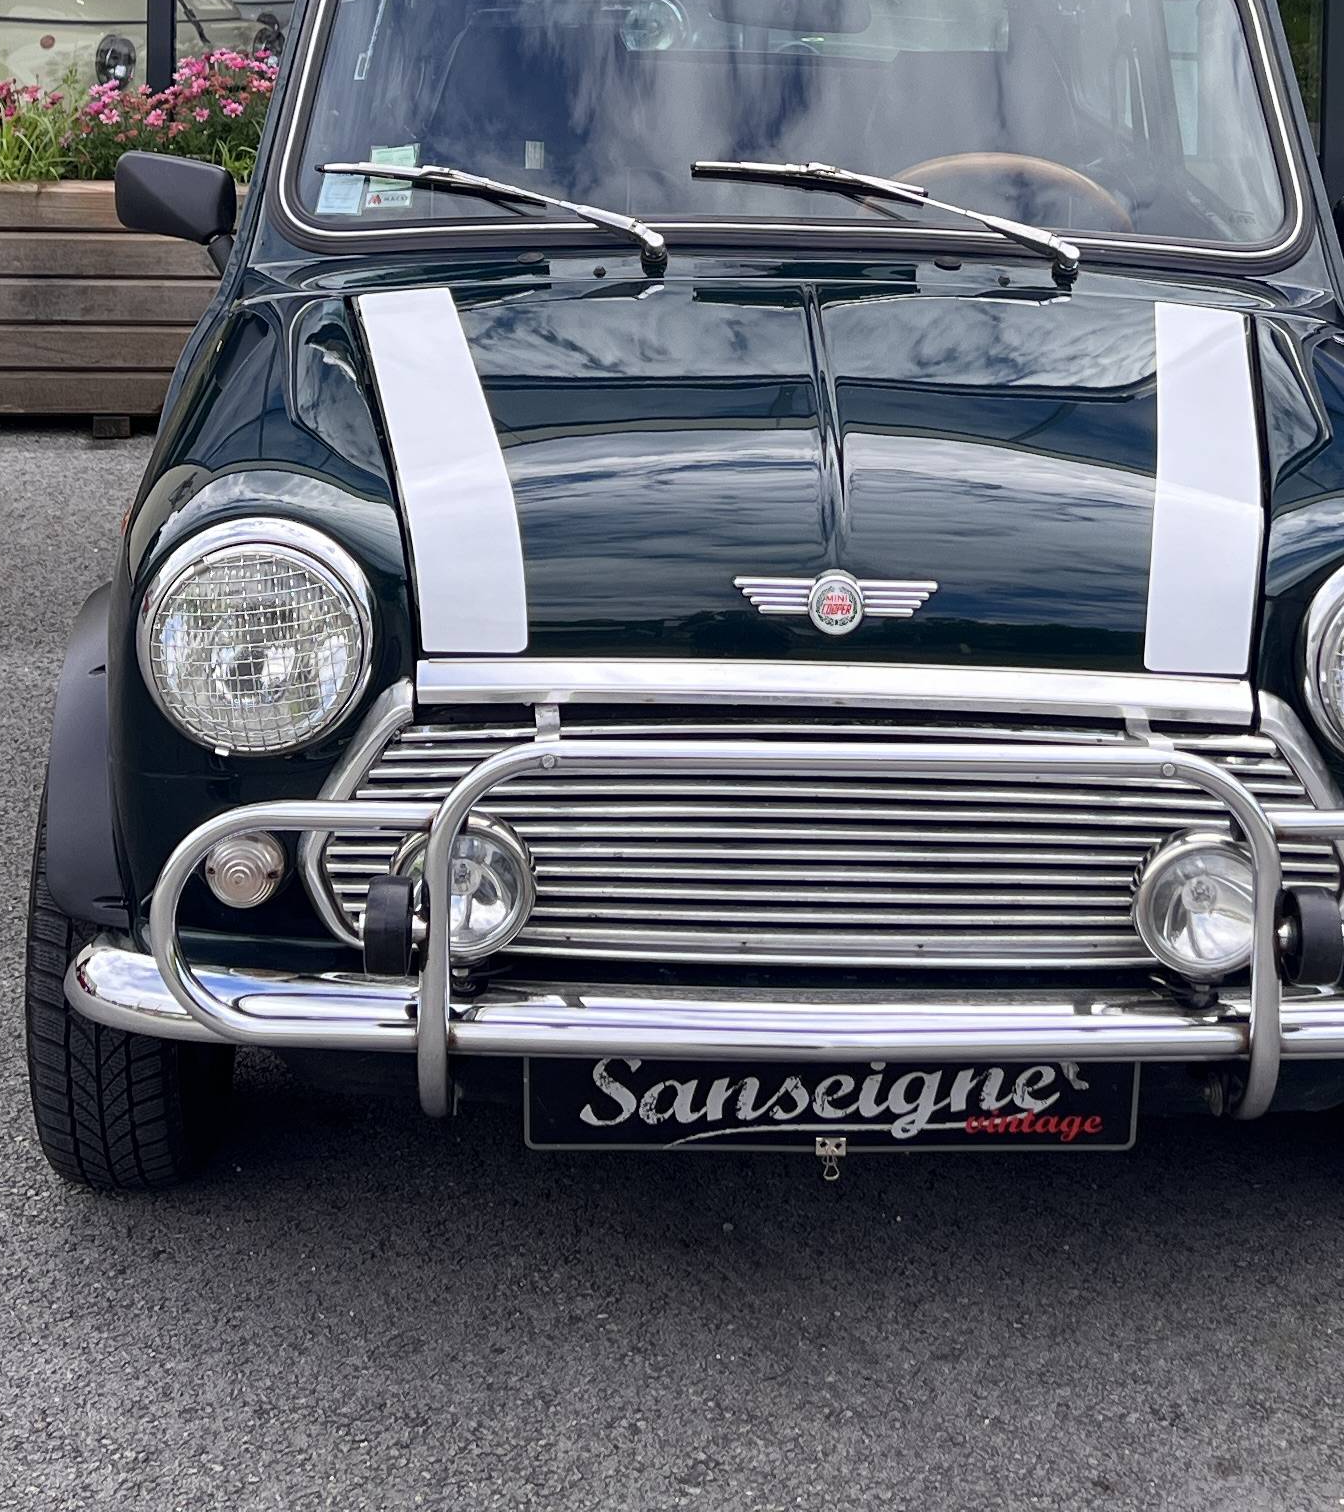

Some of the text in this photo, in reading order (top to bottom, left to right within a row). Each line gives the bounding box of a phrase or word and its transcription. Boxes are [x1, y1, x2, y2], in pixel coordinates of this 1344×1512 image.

[821, 603, 852, 616] COOPER
[825, 594, 848, 603] MINI
[580, 1057, 1061, 1138] Sanseigne
[964, 1109, 1104, 1142] vintage
